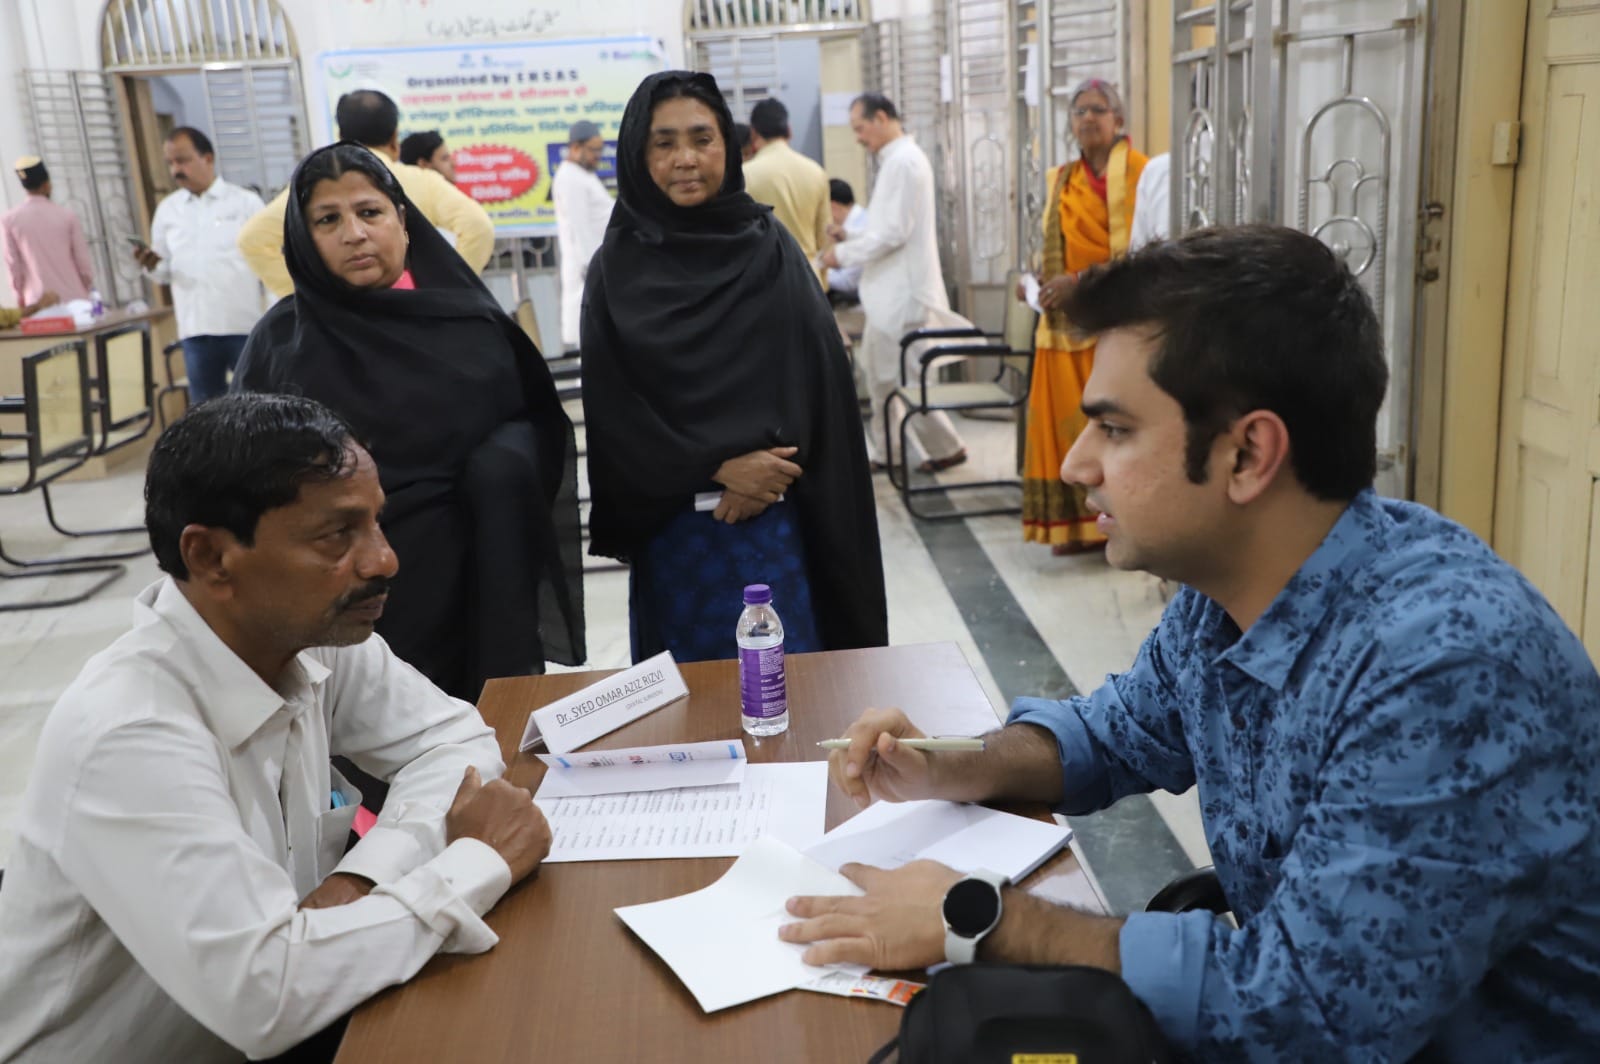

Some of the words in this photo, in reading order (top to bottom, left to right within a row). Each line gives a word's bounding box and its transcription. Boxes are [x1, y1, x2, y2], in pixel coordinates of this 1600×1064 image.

[556, 712, 572, 725] Dr.
[571, 699, 596, 718] SYED
[596, 687, 623, 708] OMAR
[624, 677, 643, 695] AZIZ
[643, 669, 664, 687] RIZVI
